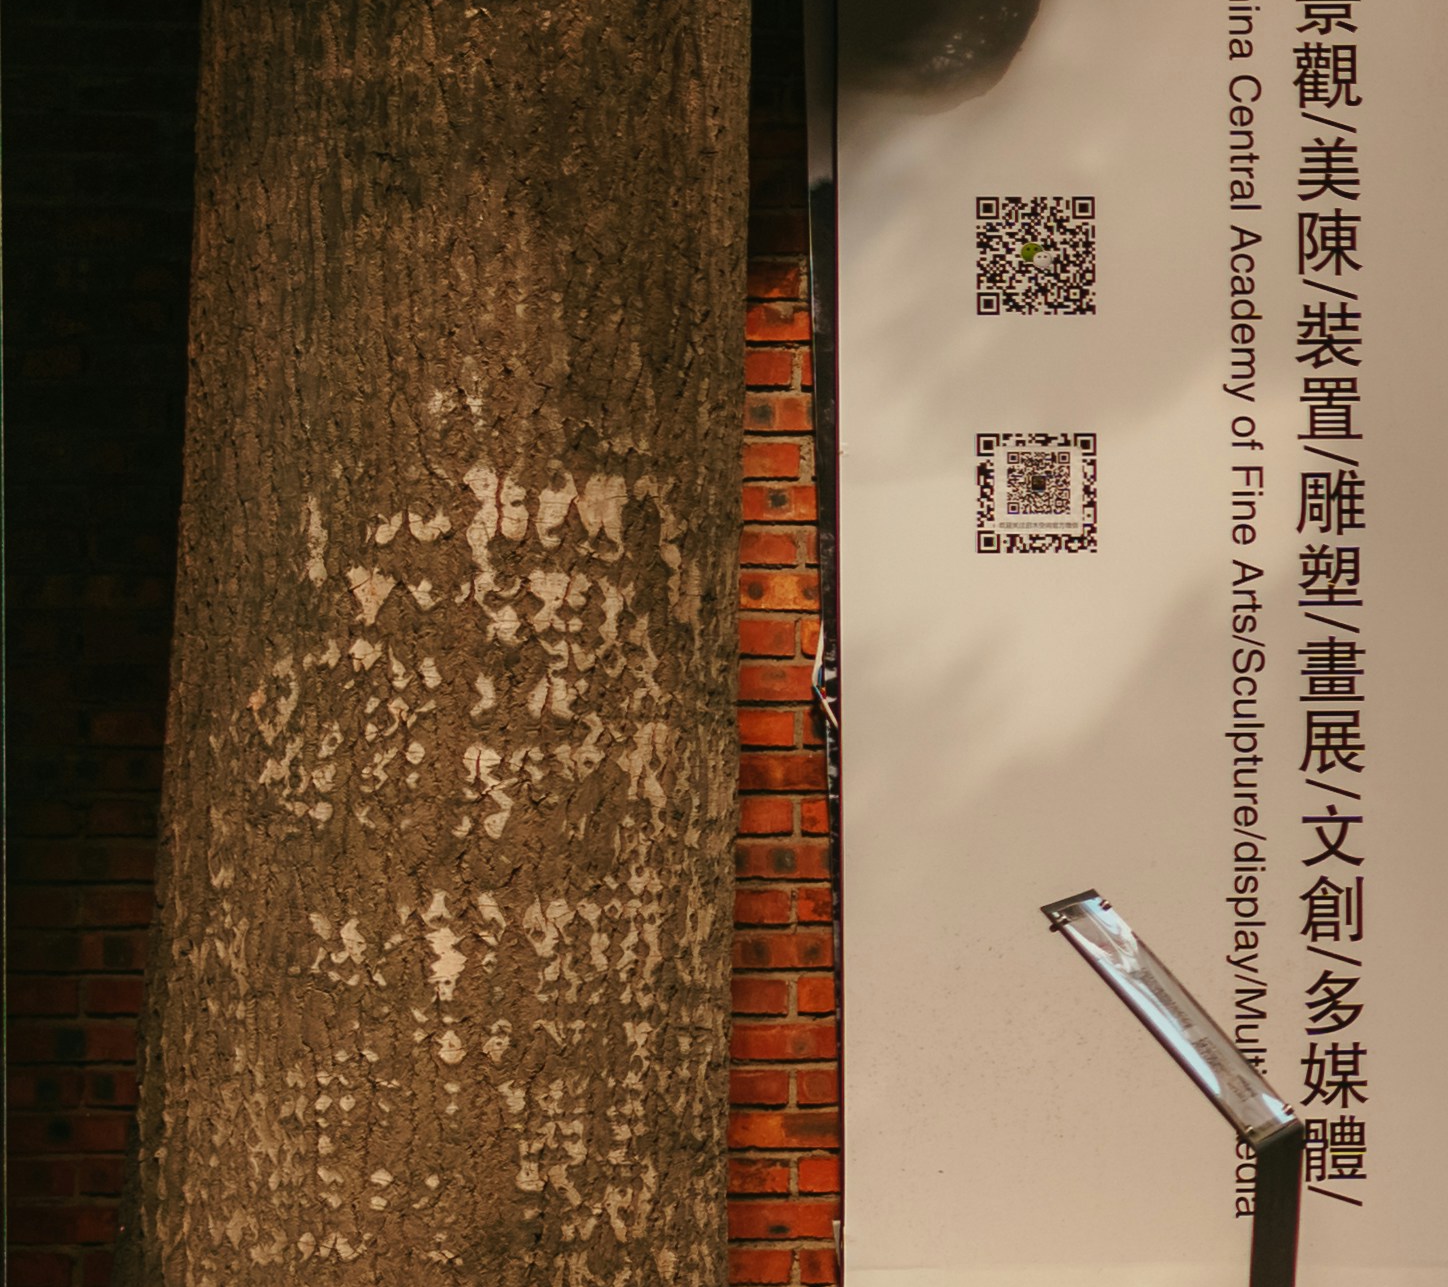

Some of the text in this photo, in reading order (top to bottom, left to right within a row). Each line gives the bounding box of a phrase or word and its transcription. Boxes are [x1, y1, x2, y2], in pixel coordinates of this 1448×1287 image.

[1229, 74, 1262, 211] Central
[1222, 223, 1263, 404] Academy
[1231, 415, 1264, 452] of
[1231, 465, 1265, 546] Fine
